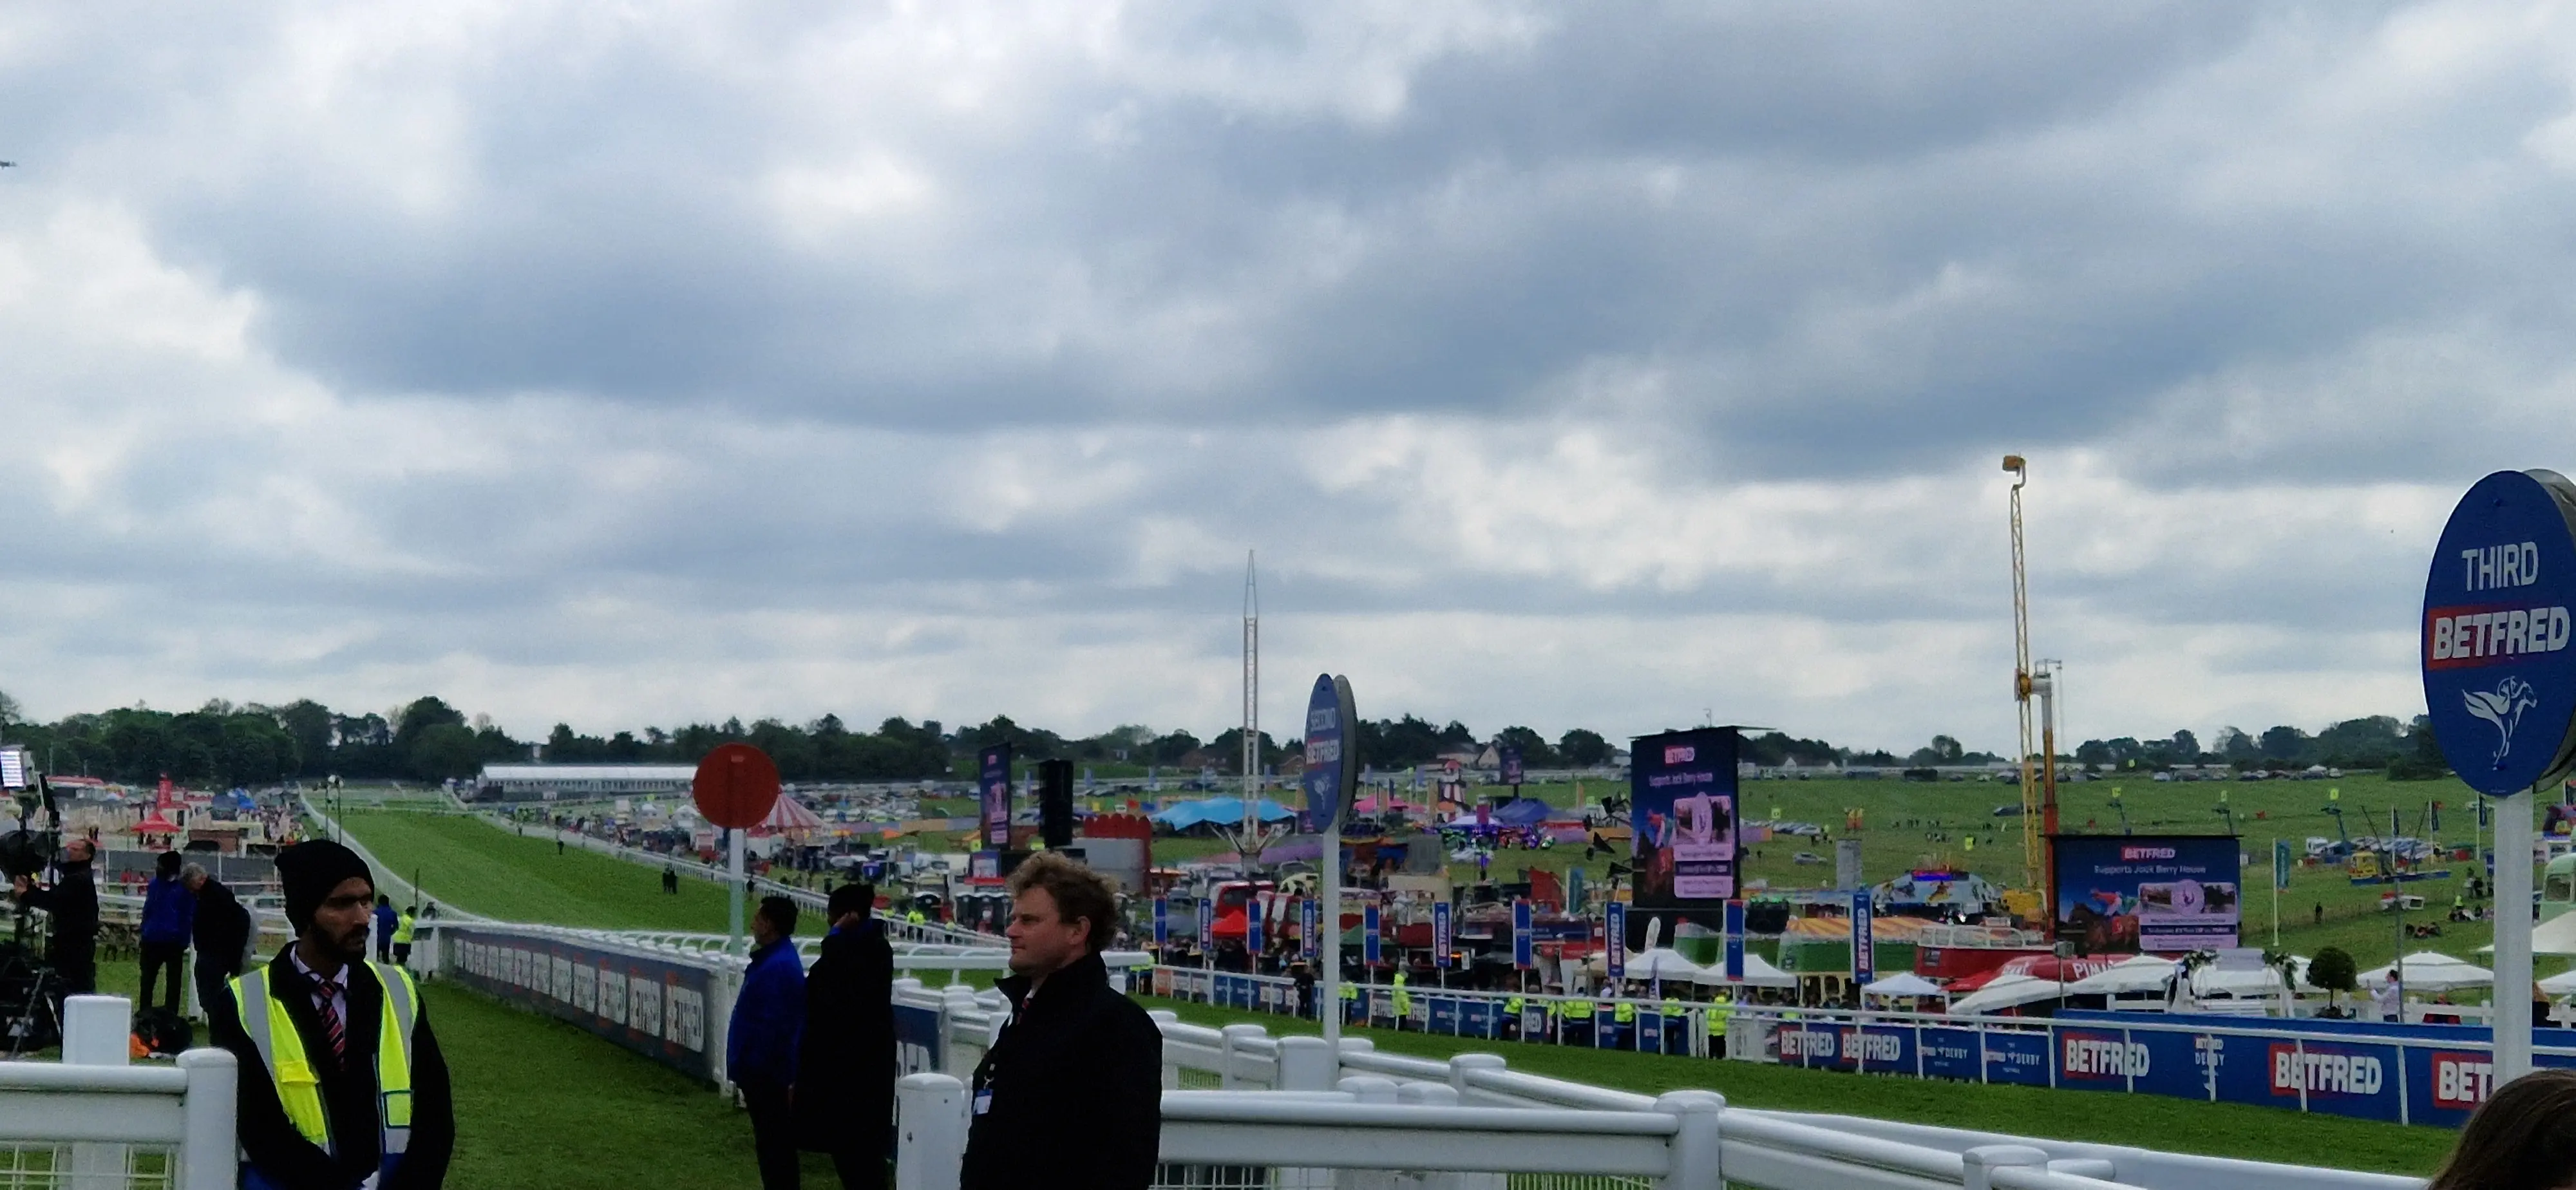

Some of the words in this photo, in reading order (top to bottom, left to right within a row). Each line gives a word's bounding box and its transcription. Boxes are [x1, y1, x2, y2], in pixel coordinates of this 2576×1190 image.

[2461, 541, 2539, 591] THIRD
[2432, 606, 2571, 660] BETFRED
[2124, 847, 2176, 859] BETFRED
[1857, 908, 1868, 970] BETFRED
[1781, 1031, 1835, 1057] BETFRED
[1842, 1033, 1900, 1061] BETFRED
[2066, 1039, 2150, 1077] BETFRED
[2275, 1052, 2382, 1095] BETFRED
